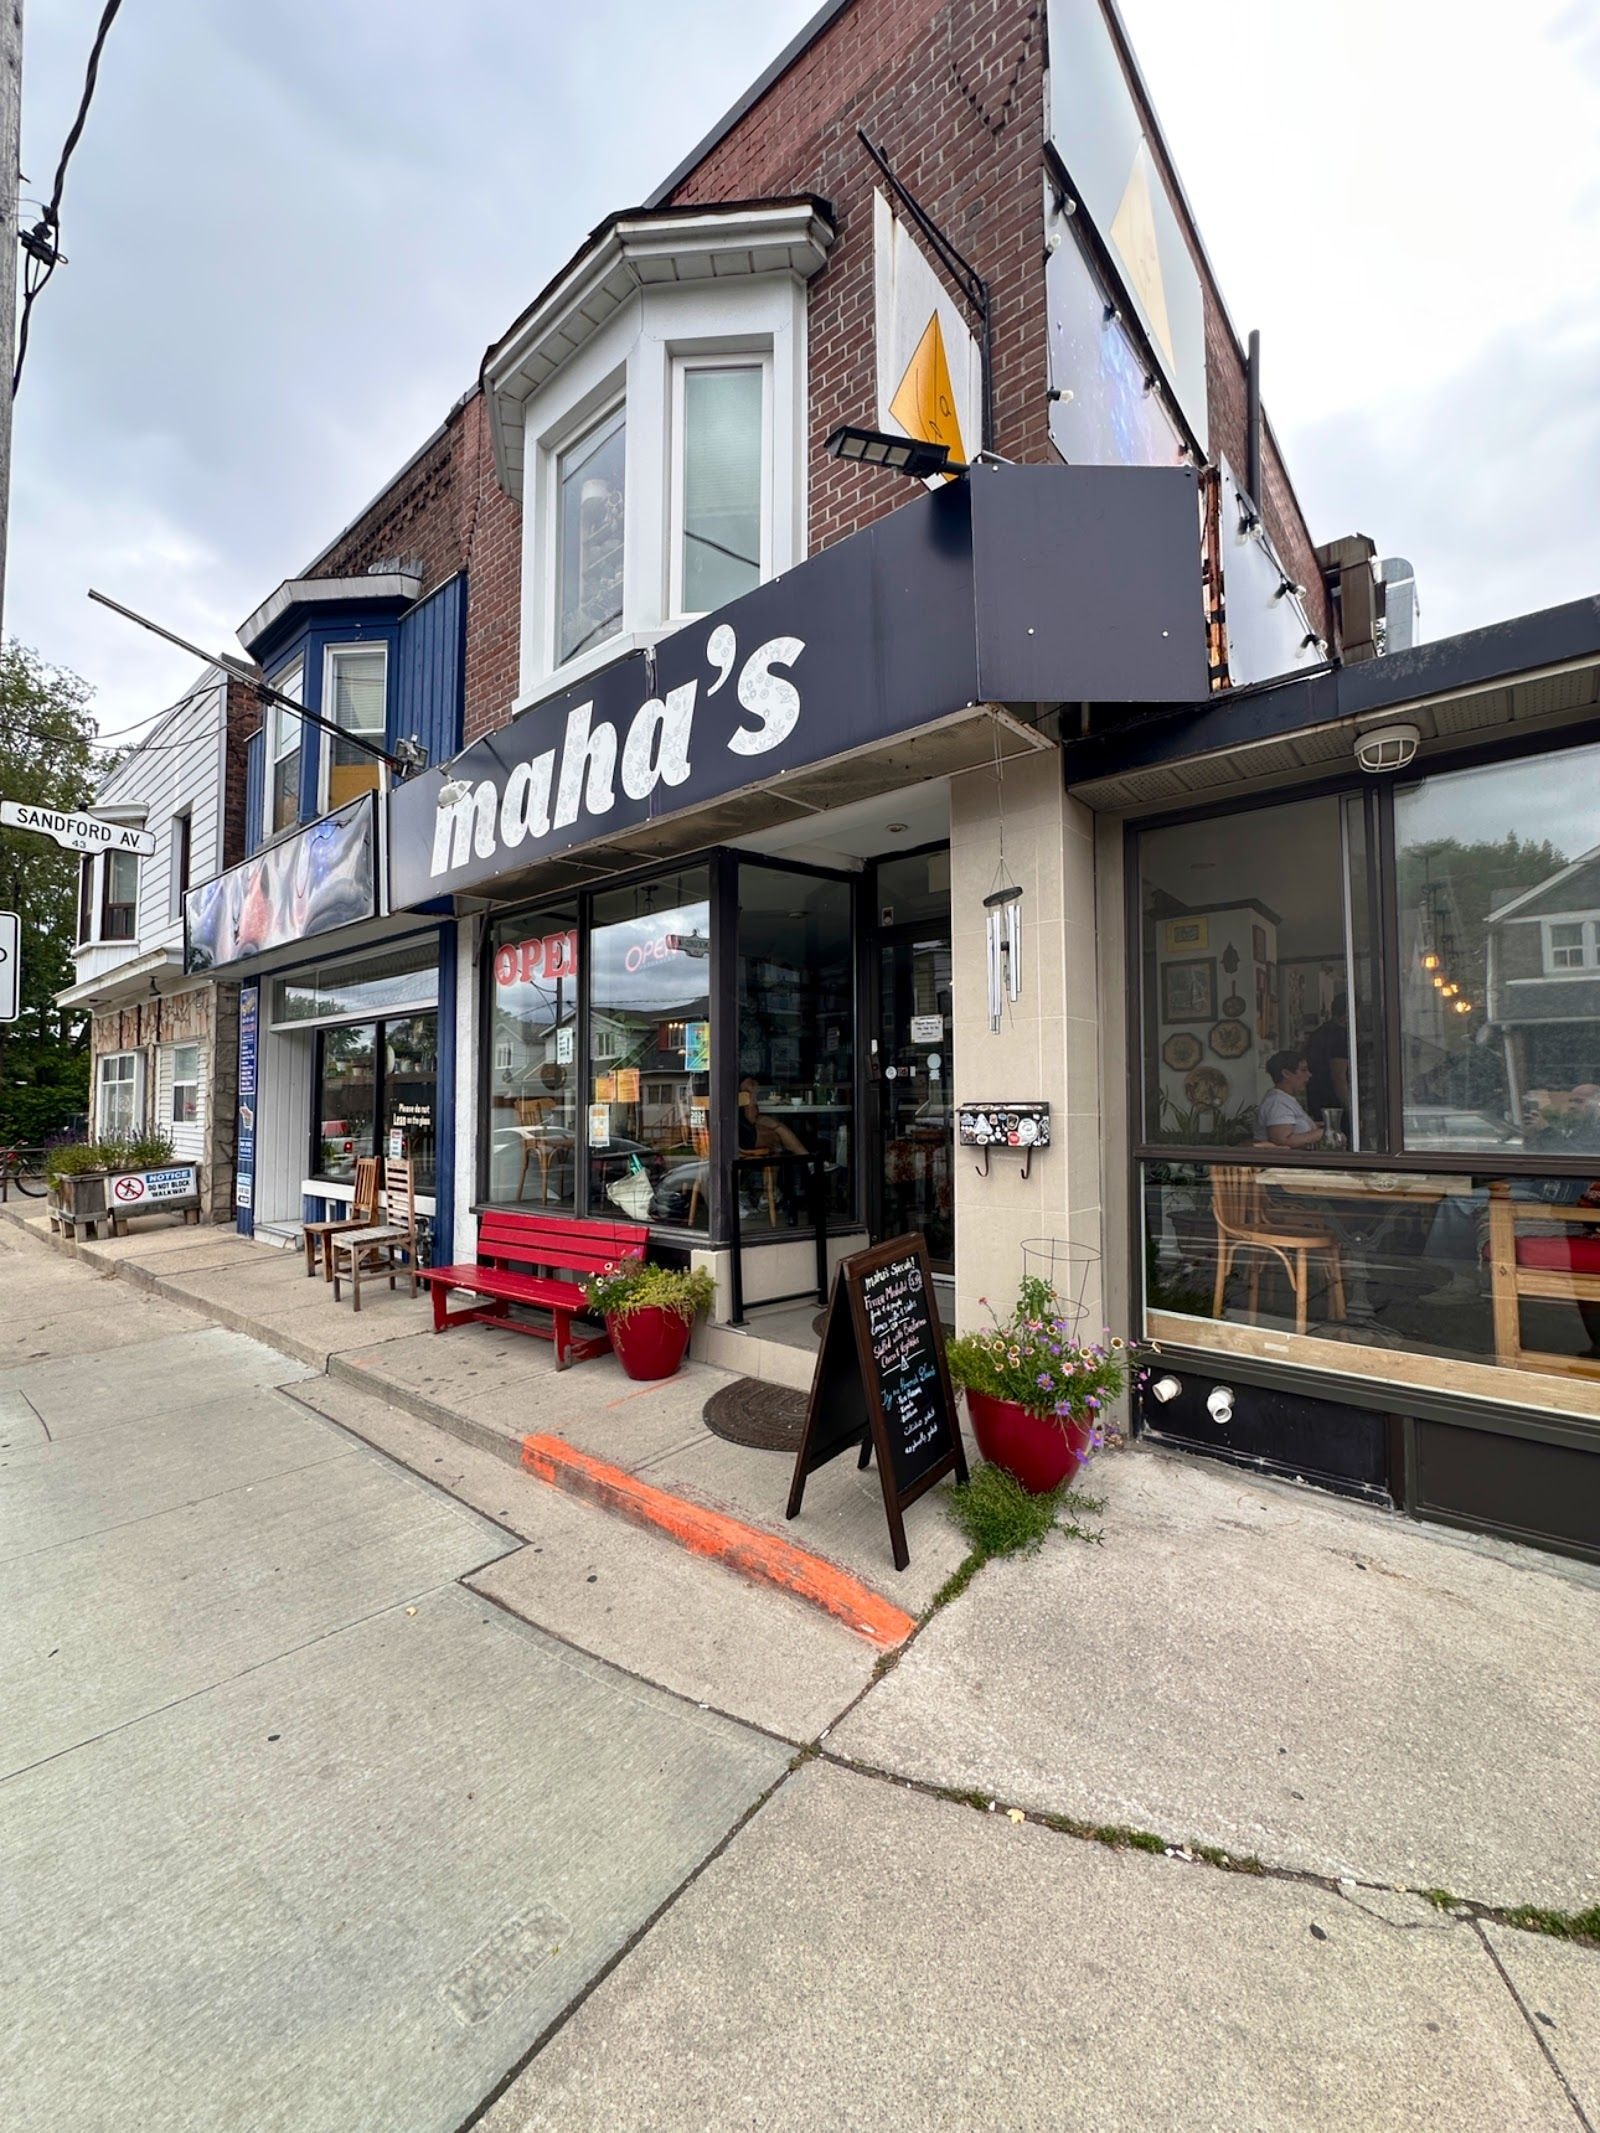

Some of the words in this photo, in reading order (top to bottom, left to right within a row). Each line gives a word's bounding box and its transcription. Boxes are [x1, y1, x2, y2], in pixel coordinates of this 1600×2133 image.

[430, 624, 806, 878] maha's
[17, 808, 112, 842] SANDFORD
[120, 832, 141, 848] AV.
[72, 839, 87, 849] 43
[149, 1171, 188, 1181] NOTICE
[171, 1180, 189, 1188] BLOCK
